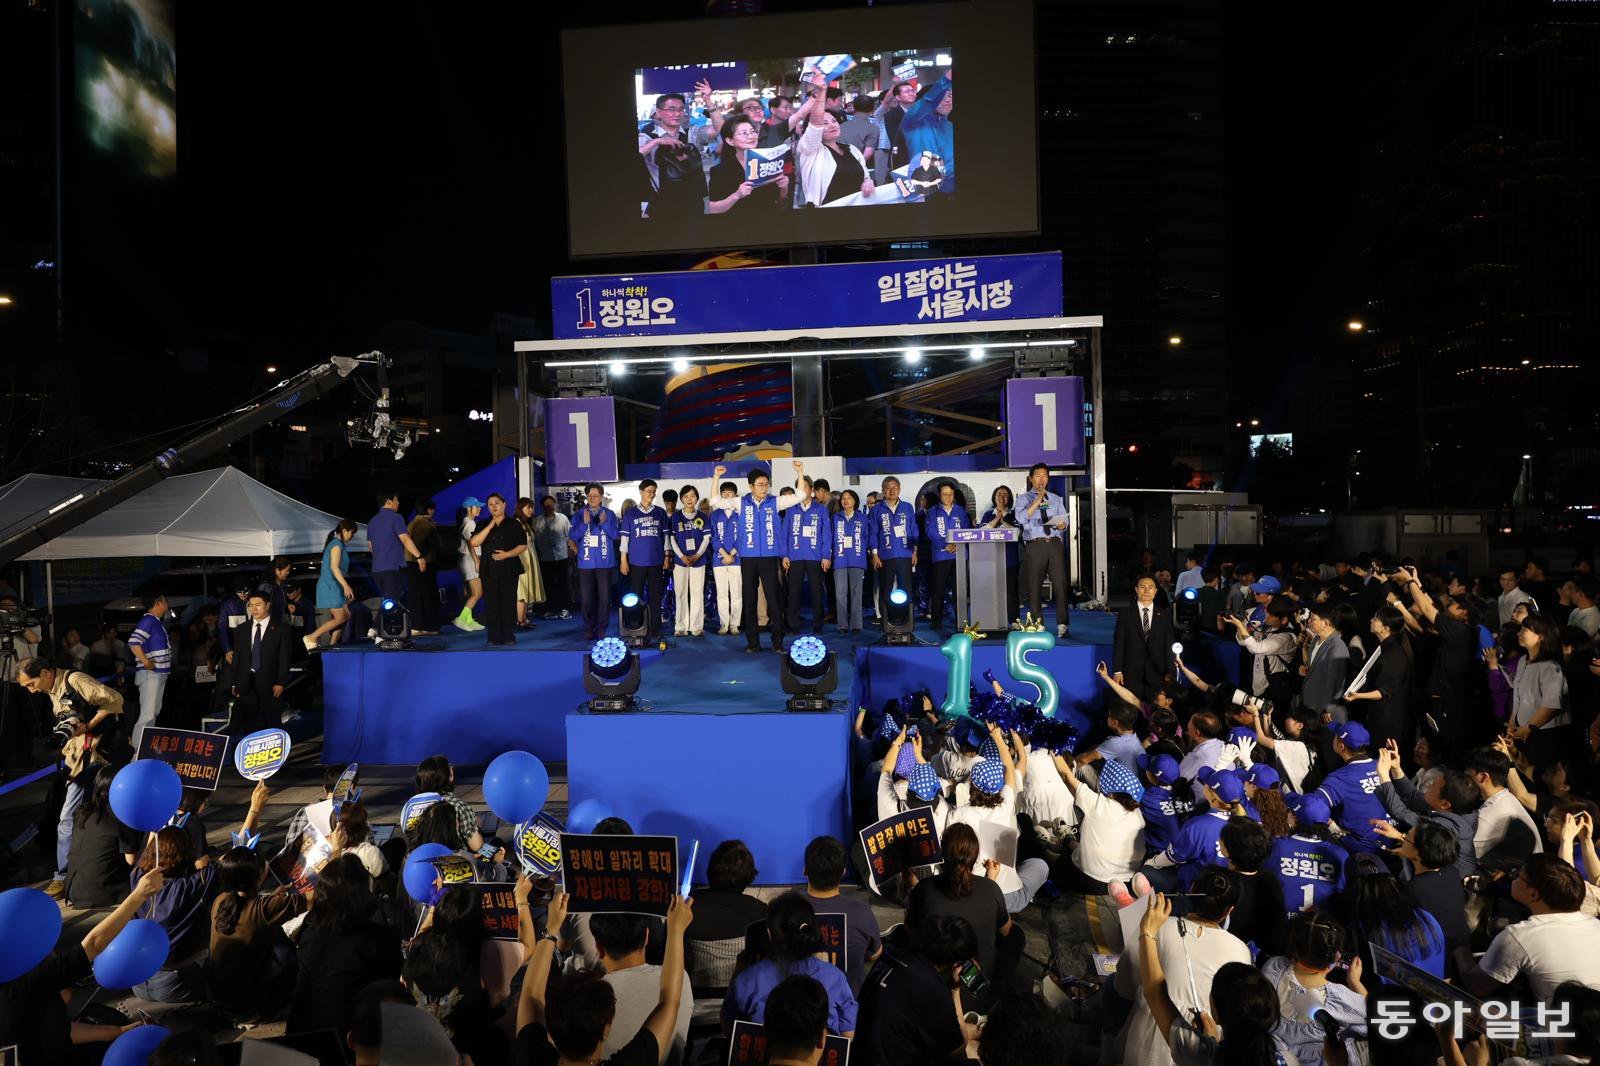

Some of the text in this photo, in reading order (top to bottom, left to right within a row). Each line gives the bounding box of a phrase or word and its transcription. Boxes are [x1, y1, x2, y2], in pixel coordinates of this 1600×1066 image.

[602, 286, 648, 298] 하나씩 착착!
[878, 262, 978, 303] 일 잘하는
[576, 288, 596, 330] 1
[599, 297, 677, 328] 정원오
[917, 279, 1013, 320] 서울시장
[1034, 392, 1057, 451] 1
[568, 412, 591, 468] 1
[150, 735, 215, 757] 서울의 미래는
[243, 747, 282, 769] 정원오
[175, 761, 217, 780] 복지입니다!
[521, 830, 561, 866] 정원오
[866, 817, 931, 855] 발달장애인도
[569, 849, 672, 873] 장애인 일자리 확대
[1280, 857, 1336, 883] 정원오
[575, 875, 670, 904] 자립지원 강화!
[1299, 883, 1317, 912] 1
